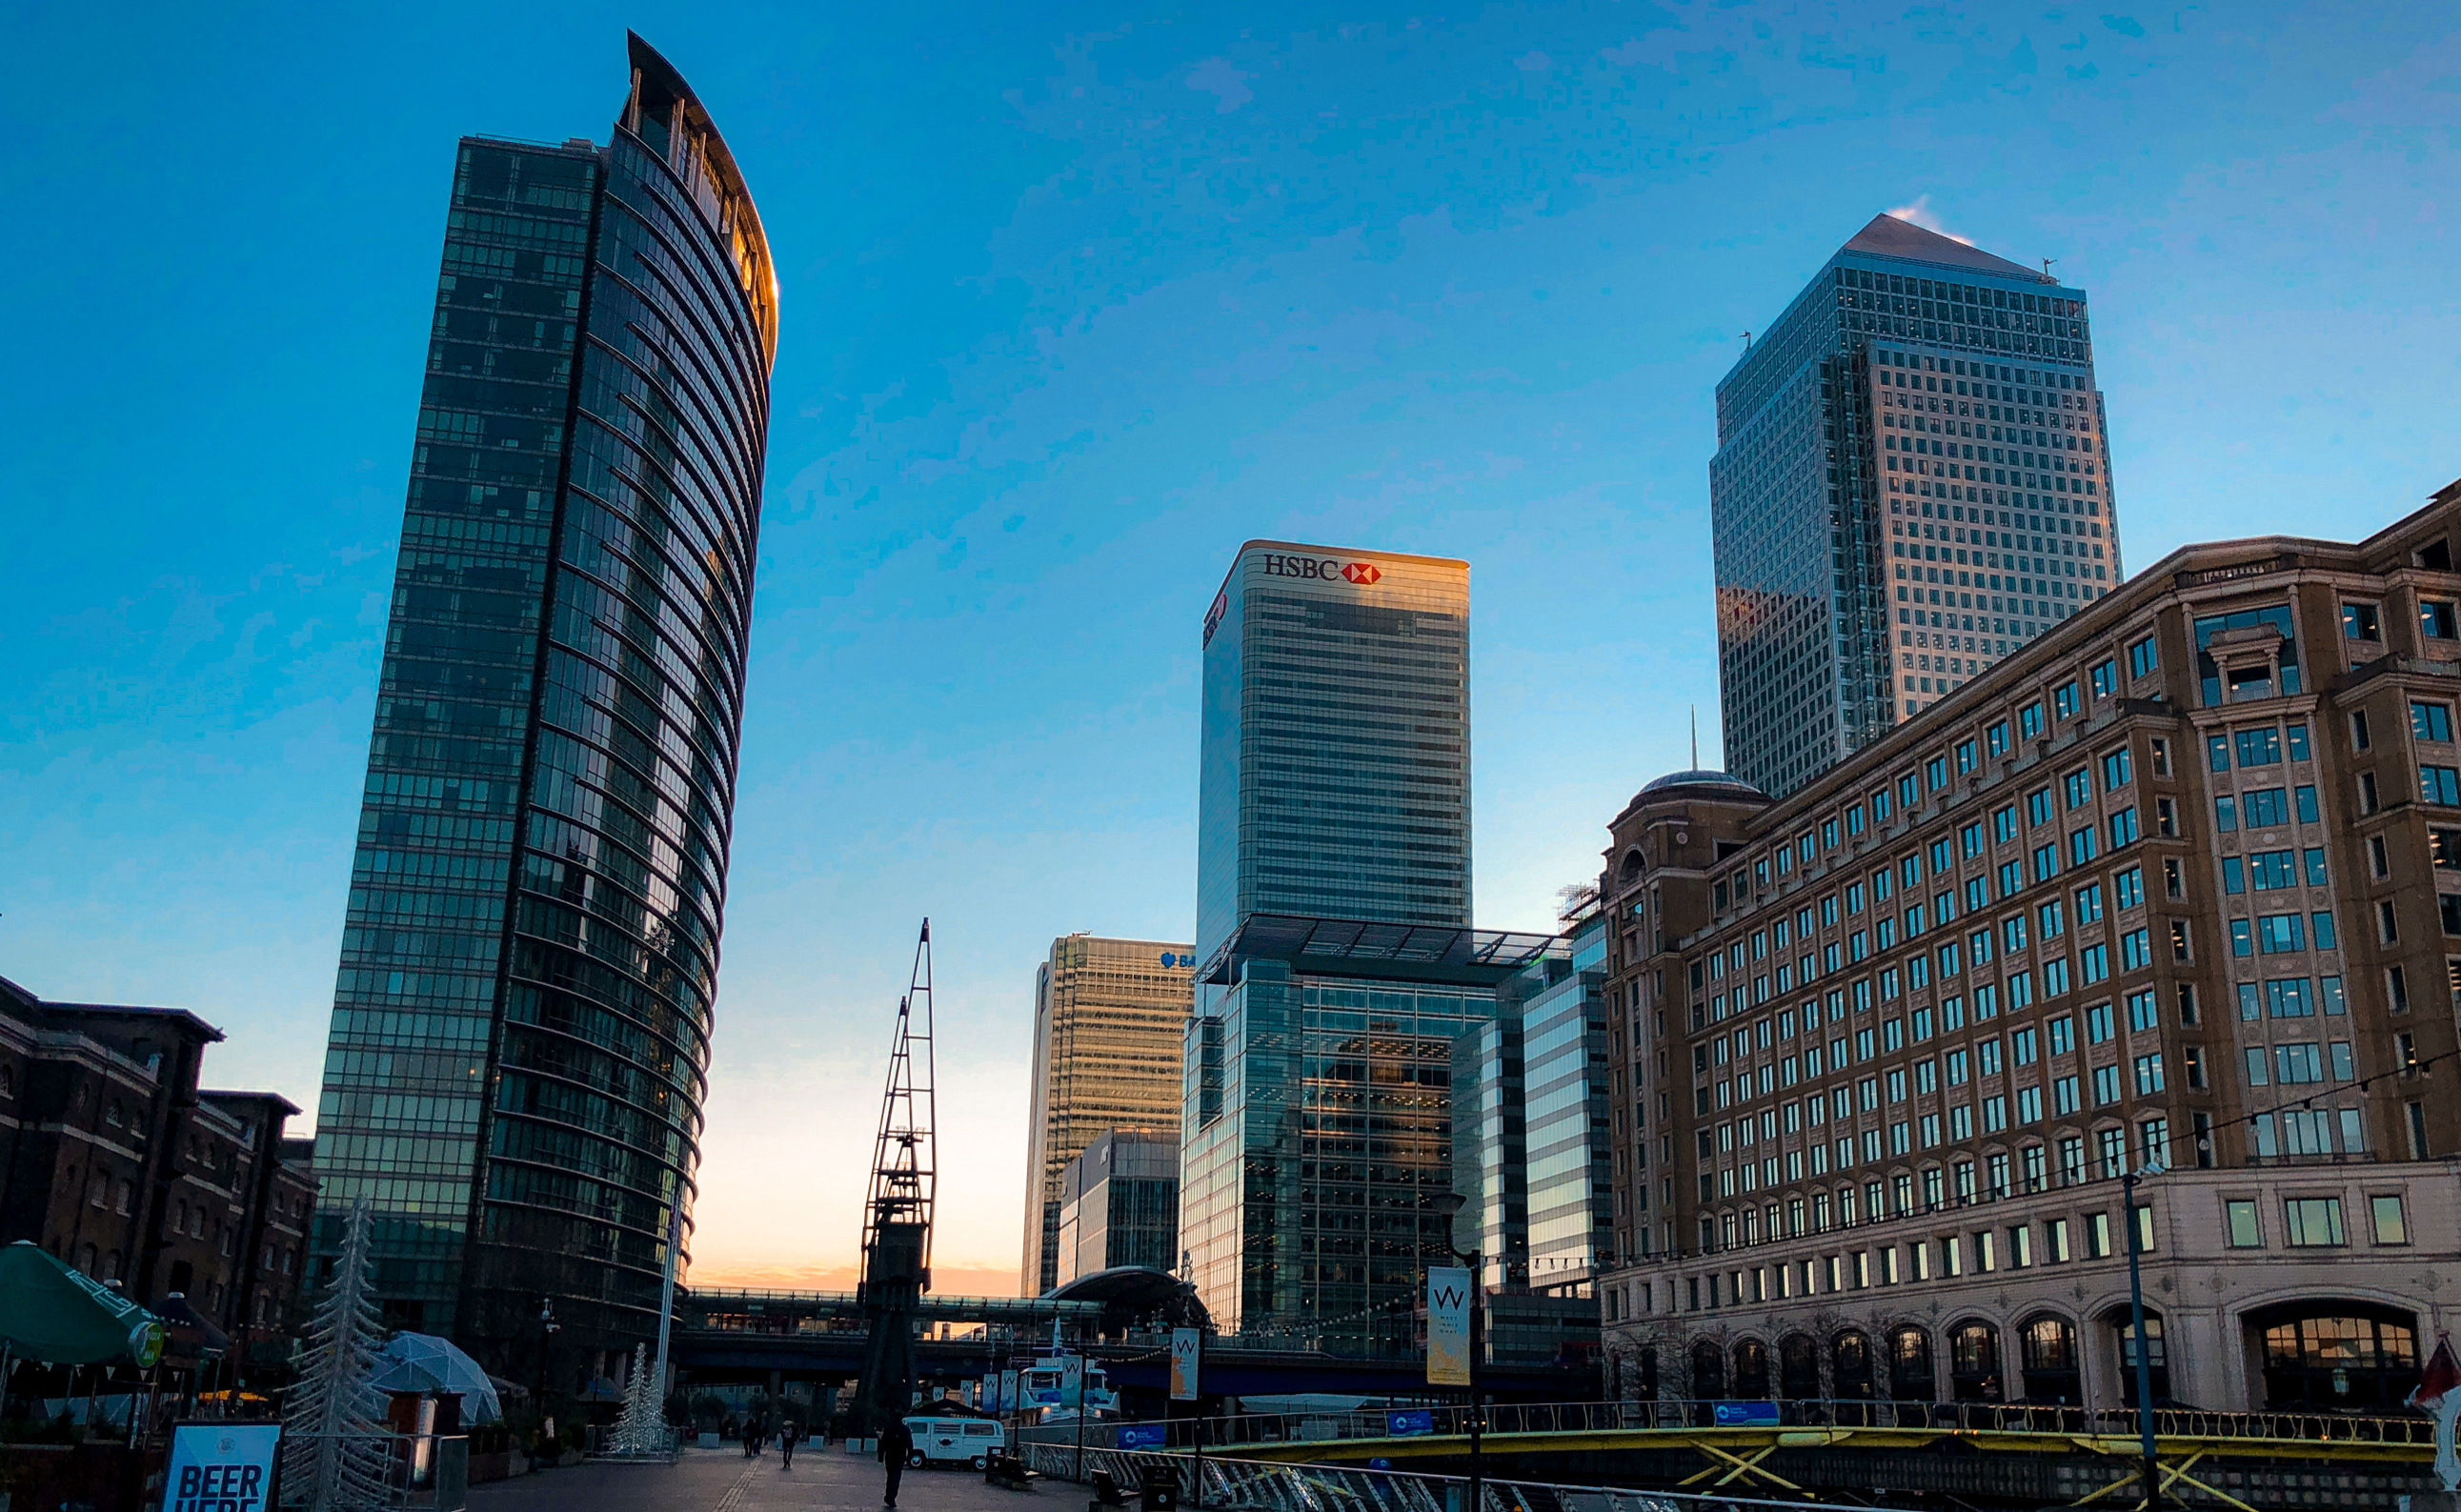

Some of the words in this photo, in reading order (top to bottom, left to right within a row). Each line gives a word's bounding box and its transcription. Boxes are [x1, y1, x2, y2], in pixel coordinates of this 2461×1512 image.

[1263, 554, 1340, 581] HSBC
[1434, 1285, 1464, 1311] W
[1177, 1340, 1195, 1354] W
[1065, 1362, 1079, 1374] W
[1004, 1376, 1016, 1385] W
[178, 1464, 262, 1498] BEER
